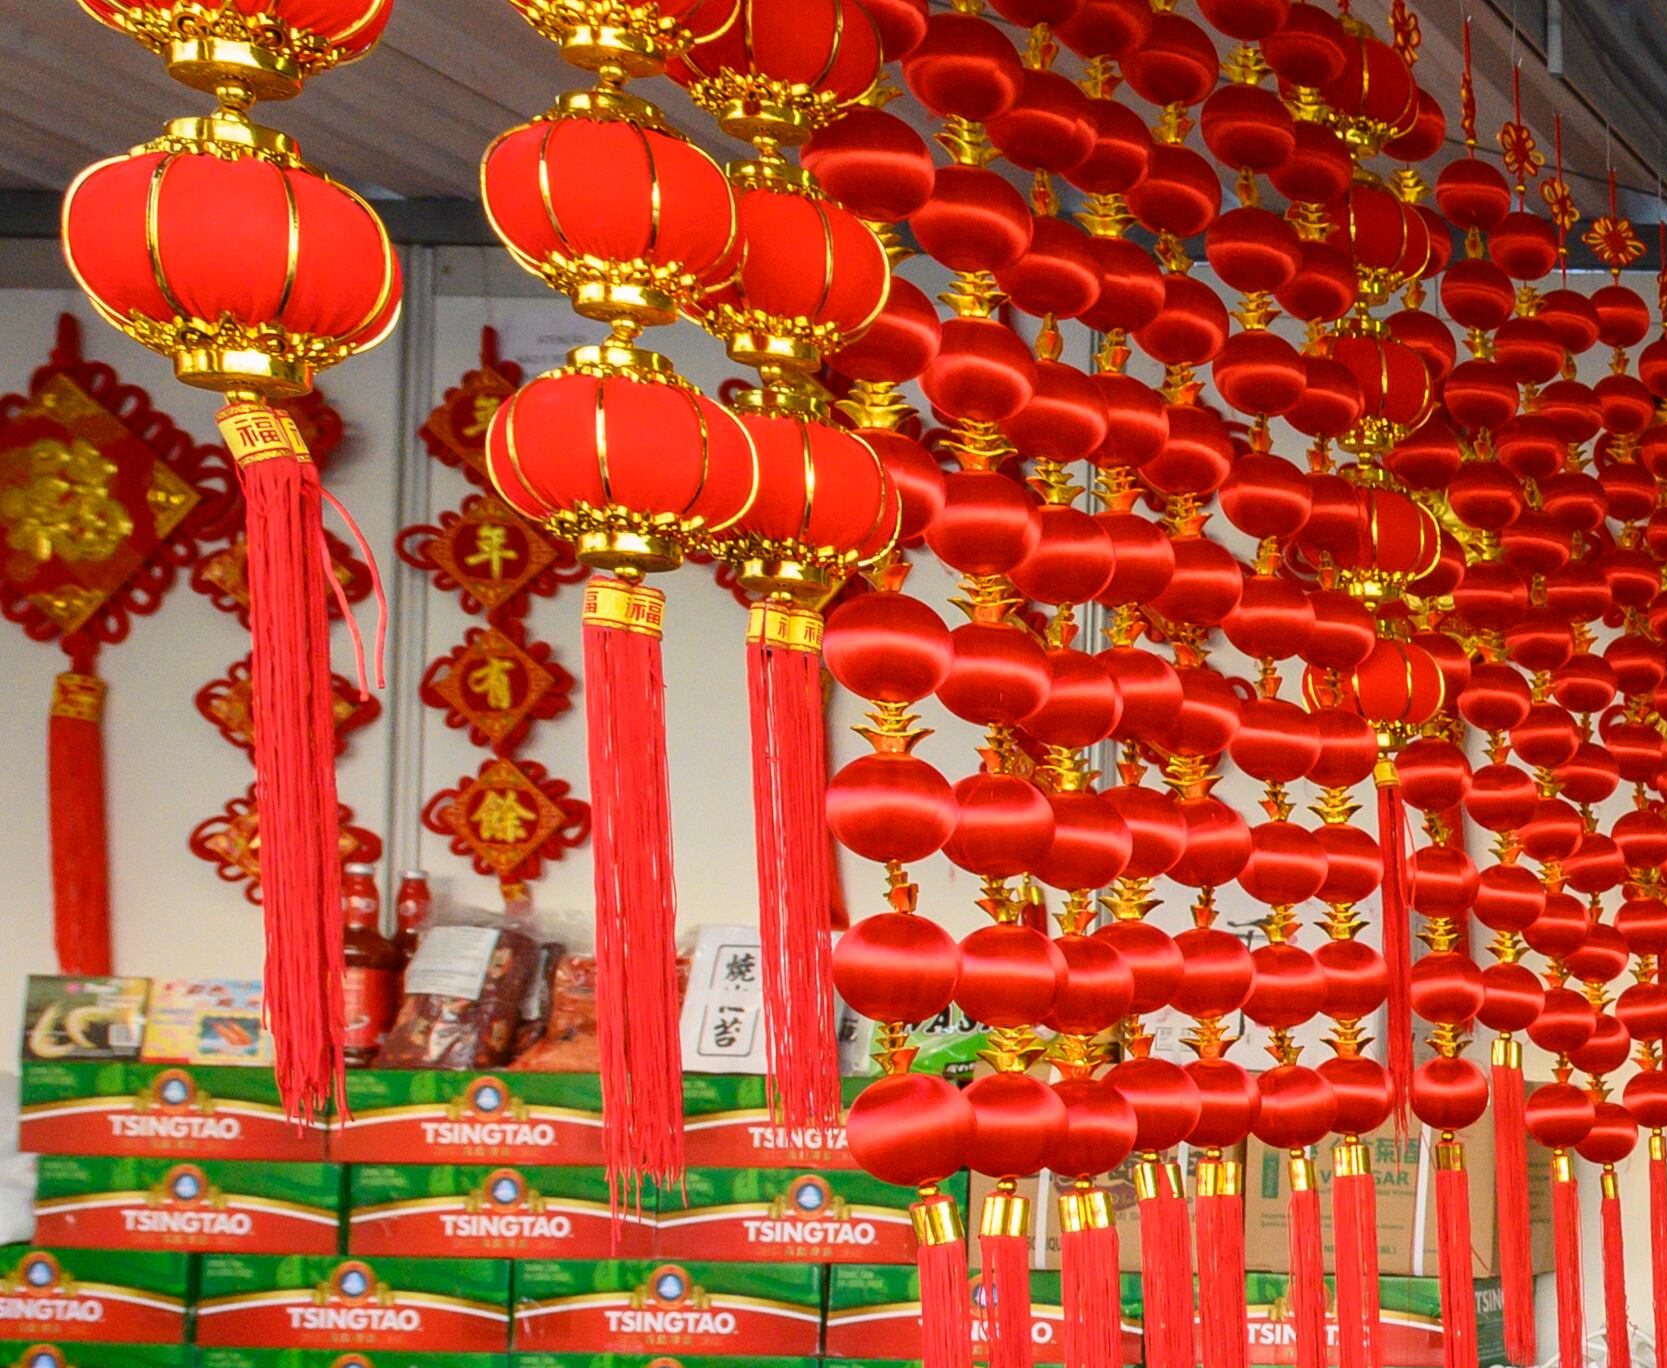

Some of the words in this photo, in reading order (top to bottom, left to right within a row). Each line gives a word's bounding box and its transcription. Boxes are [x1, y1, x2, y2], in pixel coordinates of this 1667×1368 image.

[235, 415, 281, 449] 福
[107, 1115, 240, 1140] TSINGTAO
[122, 1211, 252, 1235] TSINGTAO
[742, 1220, 877, 1244] TSINGTAO
[287, 1307, 420, 1332] TSINGTAO
